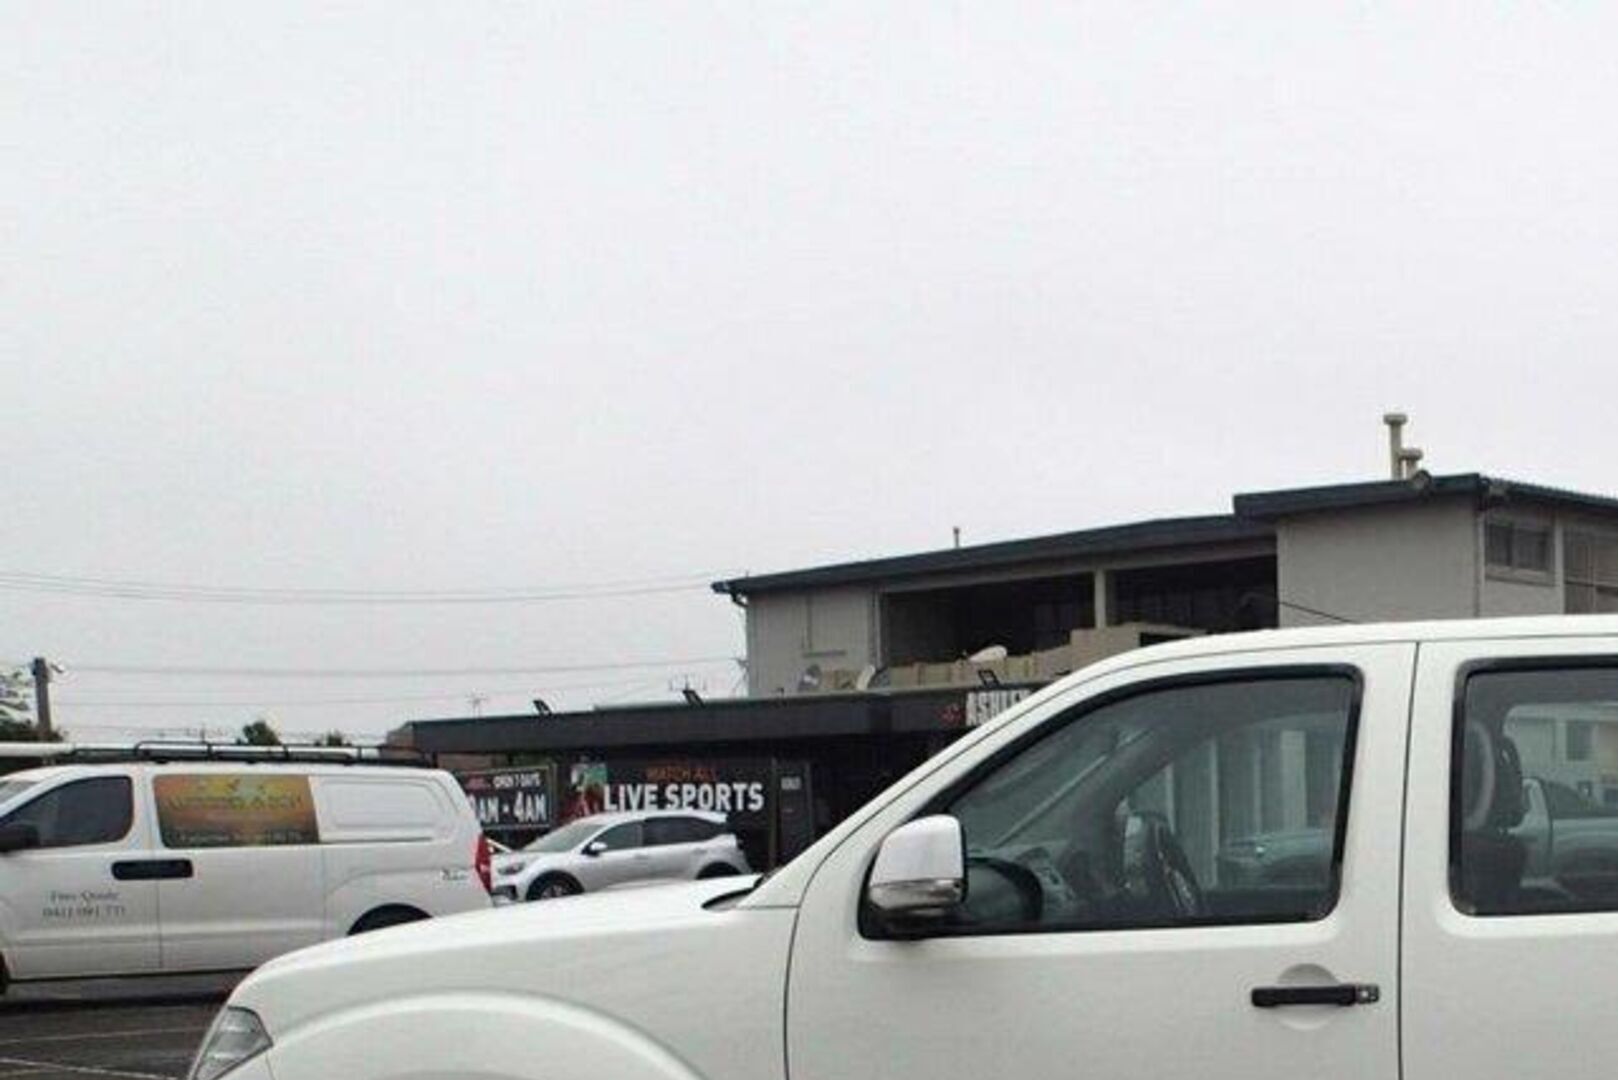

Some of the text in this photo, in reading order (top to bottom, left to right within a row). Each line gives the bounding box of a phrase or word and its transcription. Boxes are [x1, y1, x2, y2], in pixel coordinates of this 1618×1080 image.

[513, 791, 547, 823] 4AM
[603, 783, 658, 811] LIVE
[664, 781, 764, 812] SPORTS
